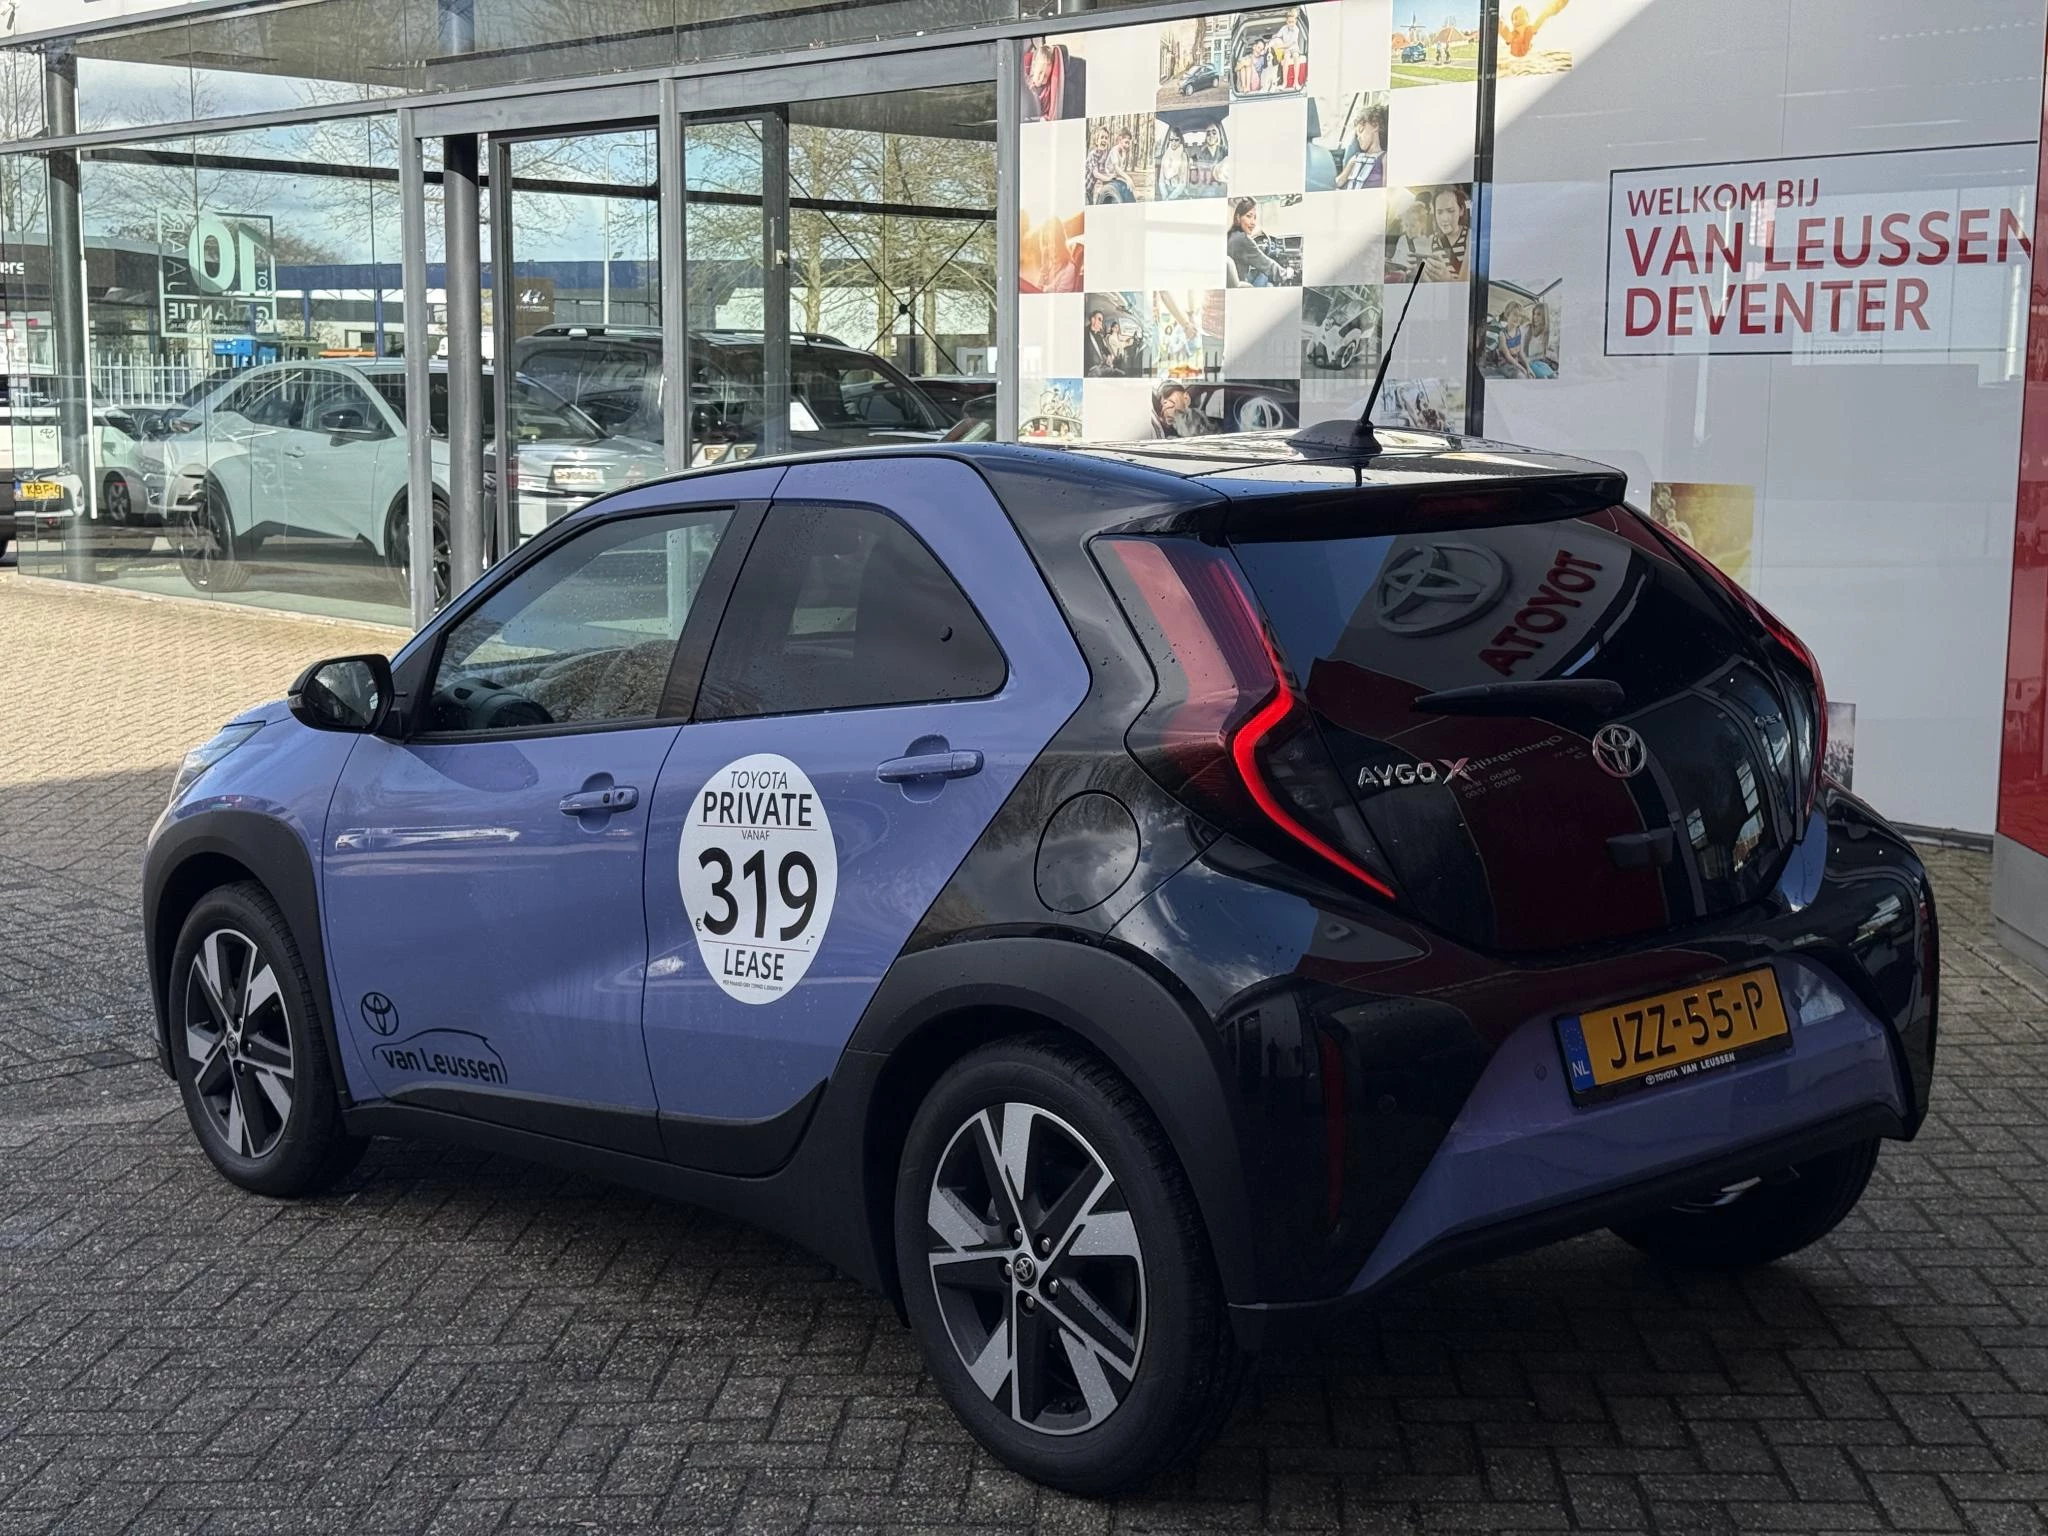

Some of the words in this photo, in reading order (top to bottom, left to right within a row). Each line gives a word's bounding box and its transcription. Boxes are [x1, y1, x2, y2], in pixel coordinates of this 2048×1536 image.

[1627, 182, 1766, 217] WELKOM
[1776, 178, 1819, 208] BIJ
[1625, 222, 1742, 277] VAN
[1765, 208, 2033, 272] LEUSSEN
[1624, 277, 1930, 336] DEVENTER
[731, 771, 788, 789] TOYOTA
[1357, 763, 1437, 788] AYGO
[703, 792, 812, 827] PRIVATE
[741, 829, 770, 841] VANAF
[724, 948, 784, 981] LEASE
[1611, 981, 1763, 1069] JZZ-55-P
[381, 1049, 421, 1071] van
[419, 1047, 503, 1084] Leussen
[1572, 1061, 1590, 1077] NL
[1655, 1069, 1679, 1082] TOYOTA
[1680, 1063, 1698, 1075] VAN
[1700, 1052, 1736, 1070] LEUSSEN
